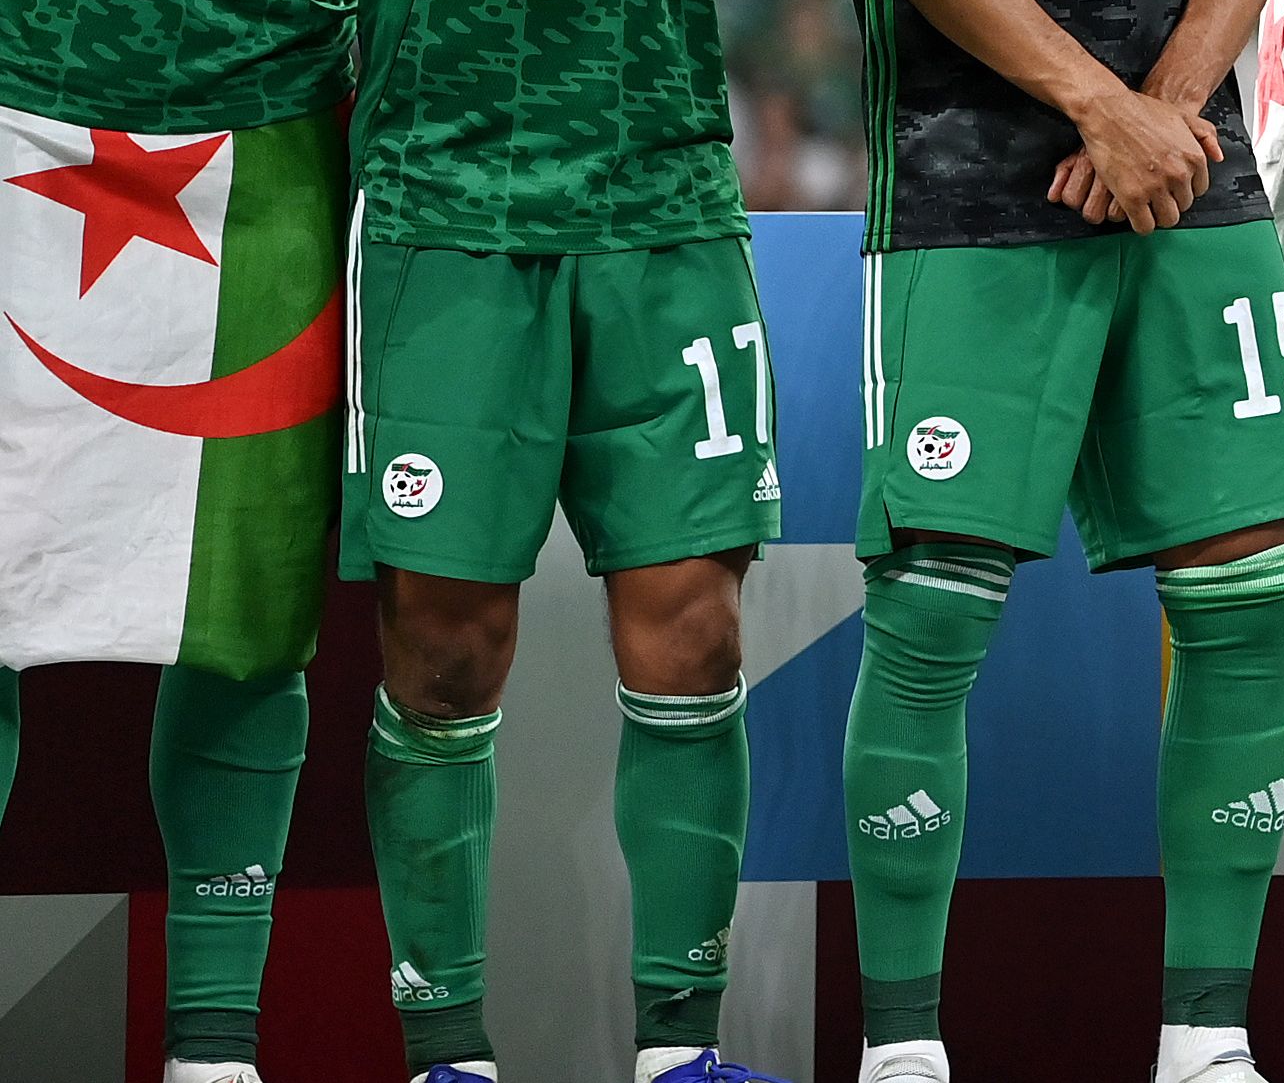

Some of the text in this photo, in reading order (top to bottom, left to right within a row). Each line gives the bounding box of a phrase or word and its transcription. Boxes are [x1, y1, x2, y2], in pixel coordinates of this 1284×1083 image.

[682, 321, 768, 459] 17
[859, 810, 951, 841] adidas
[195, 881, 274, 897] adidas
[391, 986, 449, 1002] didas
